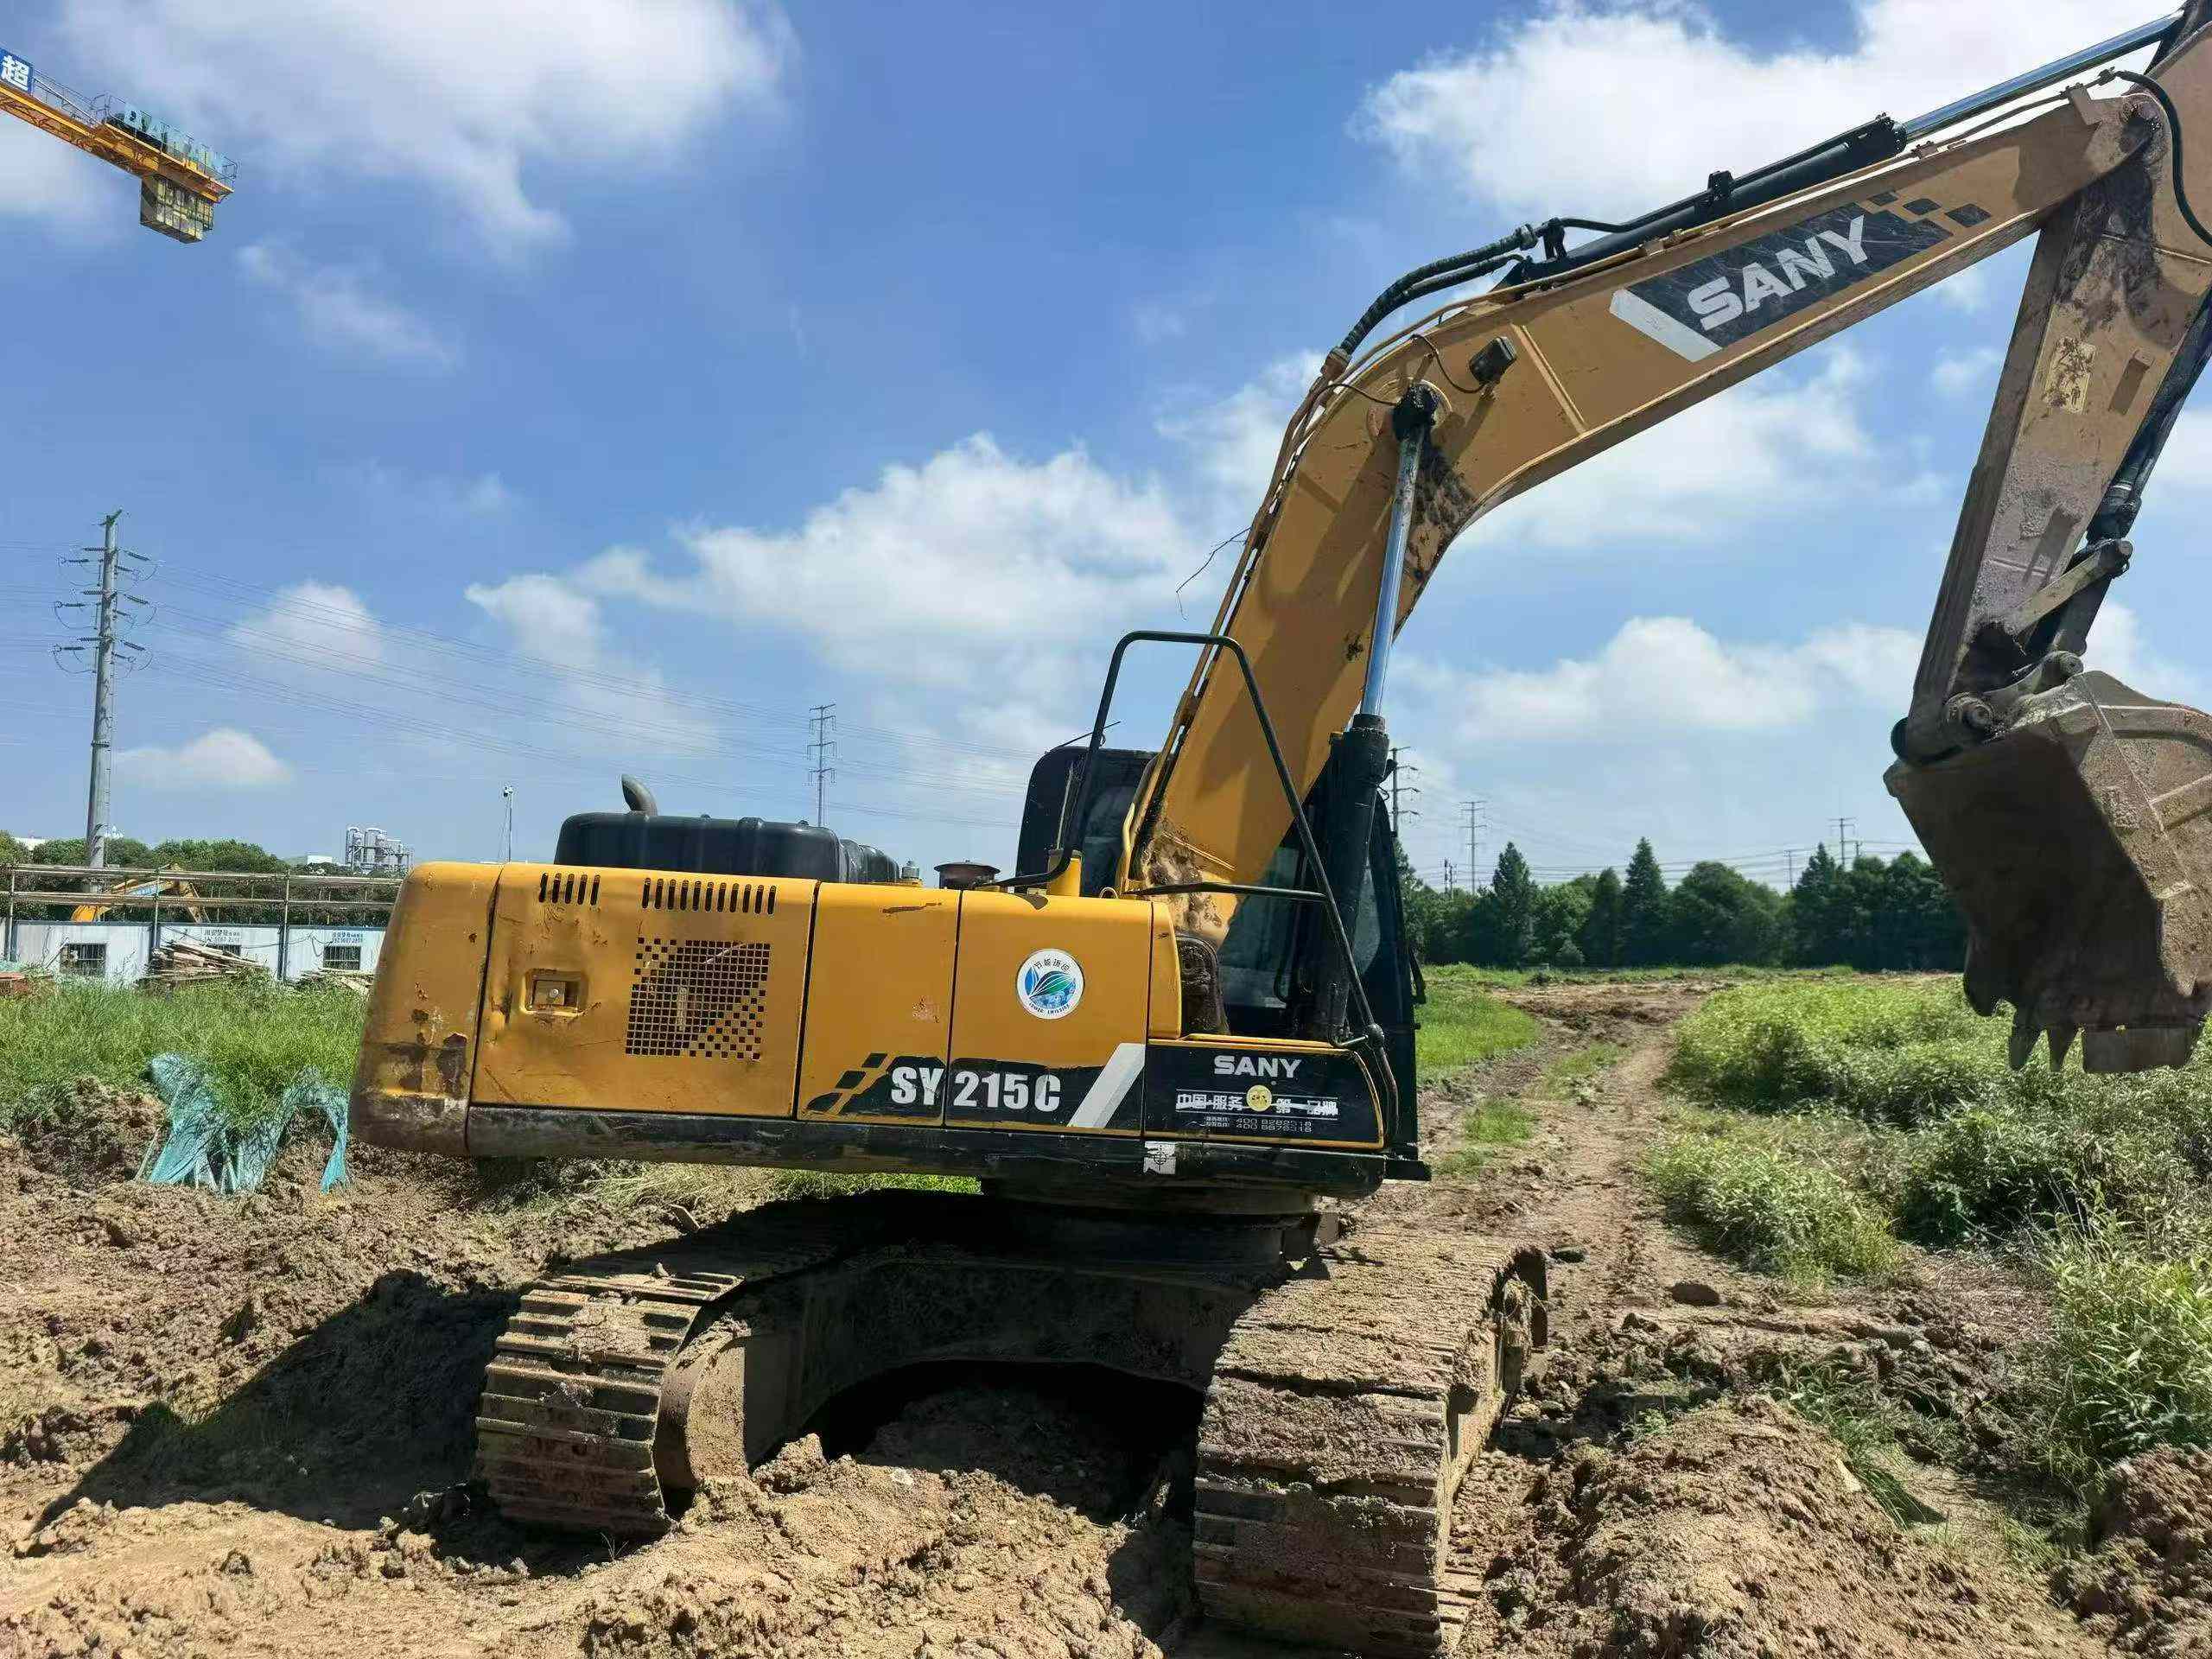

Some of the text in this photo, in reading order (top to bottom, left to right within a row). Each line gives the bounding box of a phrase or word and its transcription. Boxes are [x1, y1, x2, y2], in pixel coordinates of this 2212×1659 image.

[1, 54, 29, 91] 超
[1688, 214, 1868, 331] SANY
[1214, 1055, 1301, 1078] SANY
[891, 1066, 1062, 1112] SY 215C
